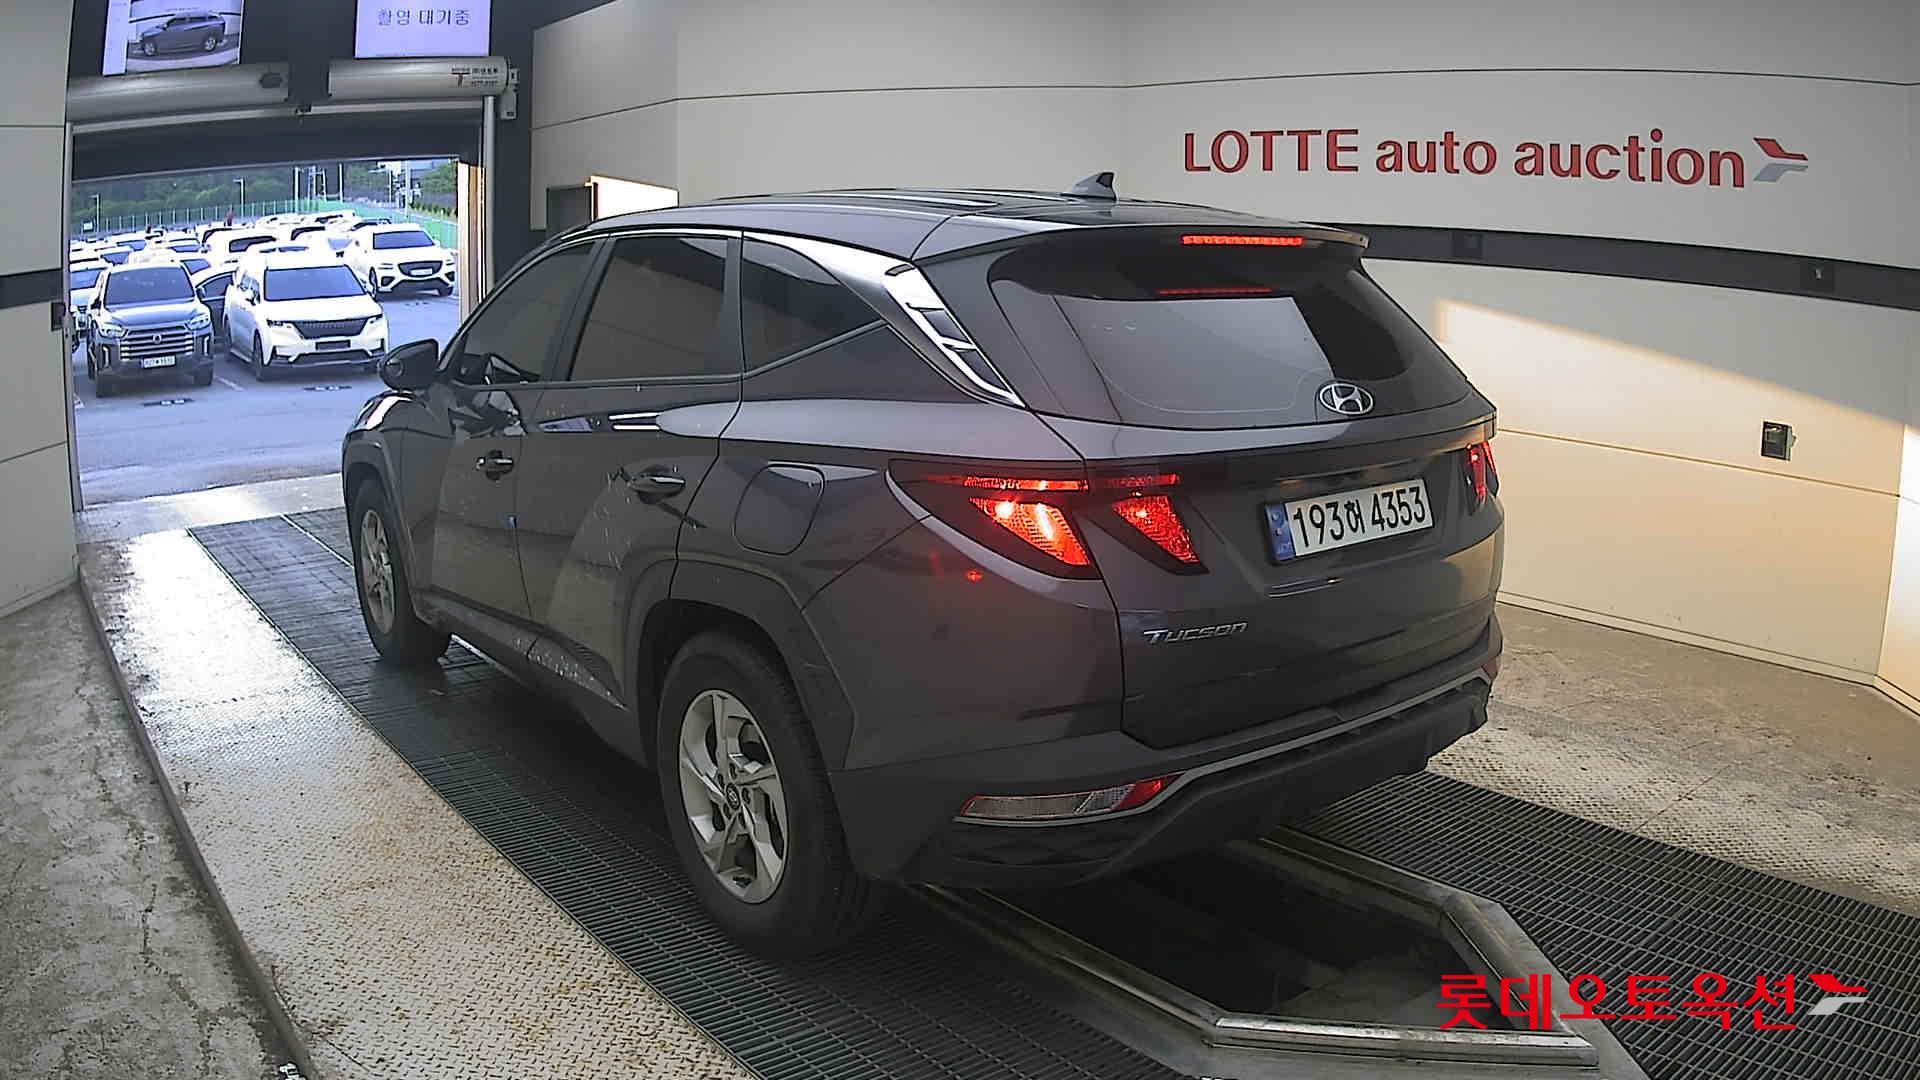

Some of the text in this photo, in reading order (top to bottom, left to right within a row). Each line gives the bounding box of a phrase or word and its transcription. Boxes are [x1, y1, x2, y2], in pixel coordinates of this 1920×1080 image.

[419, 9, 469, 26] 대기중
[1184, 128, 1745, 188] LOTTE auto auction
[1293, 486, 1426, 547] 193허 4353
